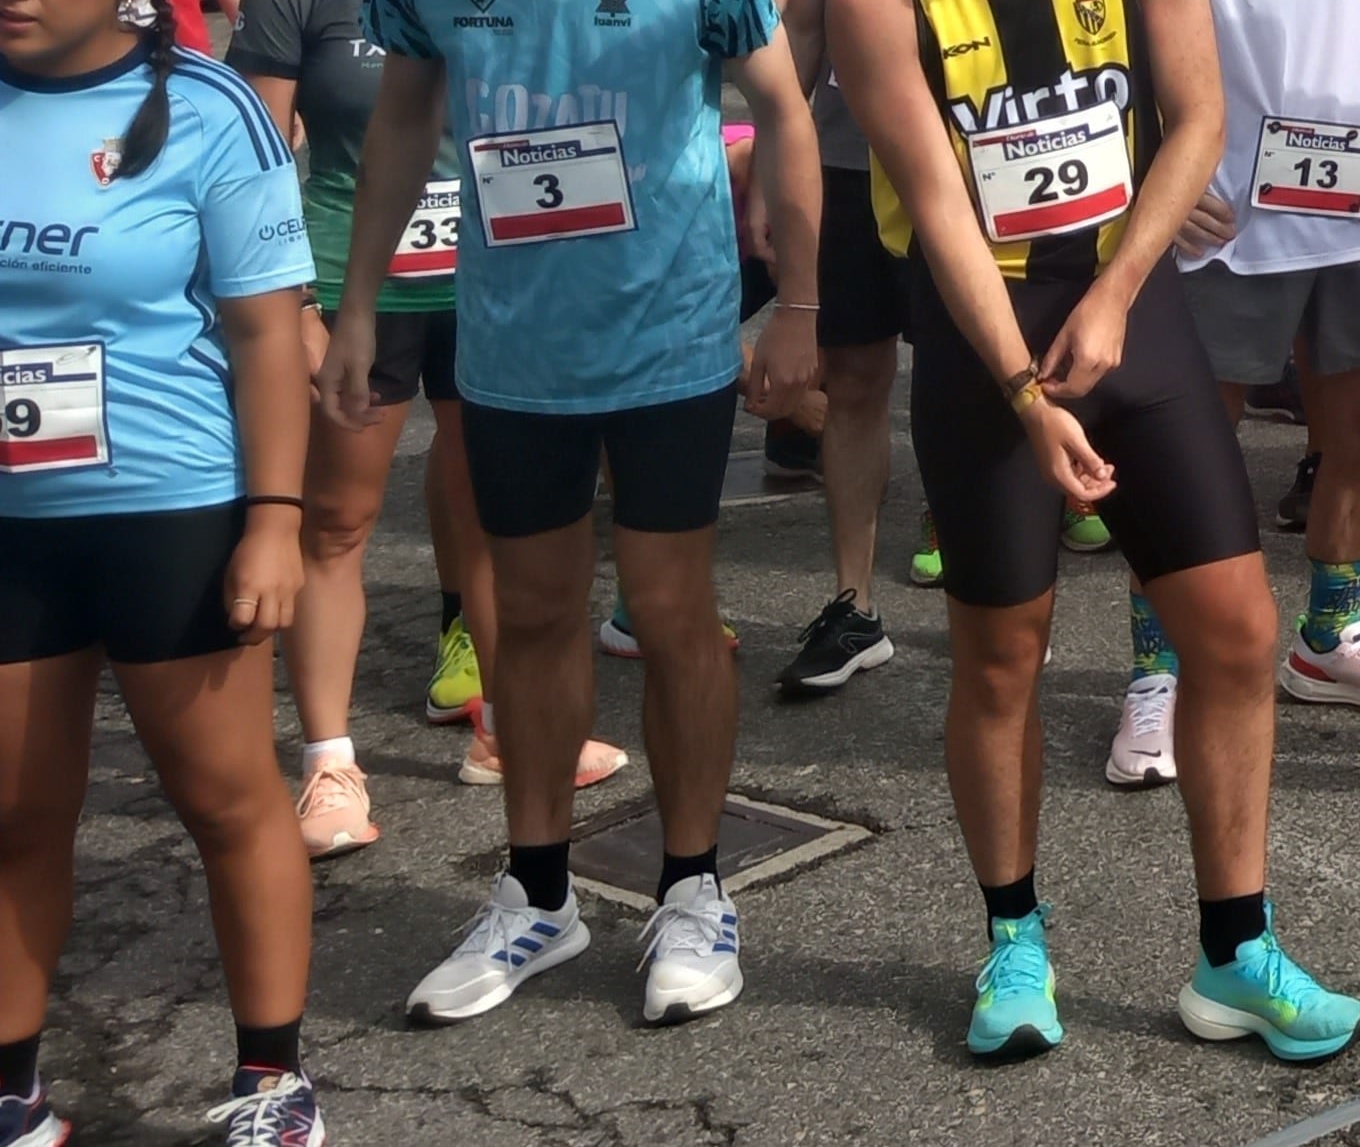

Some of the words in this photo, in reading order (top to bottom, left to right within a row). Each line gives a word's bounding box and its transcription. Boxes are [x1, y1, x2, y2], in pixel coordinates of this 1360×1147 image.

[453, 16, 514, 28] FORTUNA
[951, 66, 1129, 135] Virto
[503, 145, 577, 167] Noticias
[1006, 130, 1087, 160] Noticias
[1288, 133, 1347, 152] Noticias
[1023, 159, 1090, 206] 29
[1294, 157, 1340, 189] 13
[417, 193, 460, 209] oticia
[533, 173, 564, 209] 3
[0, 219, 100, 257] ner
[410, 217, 461, 249] 33
[32, 261, 92, 275] eficiente
[0, 398, 41, 438] 9
